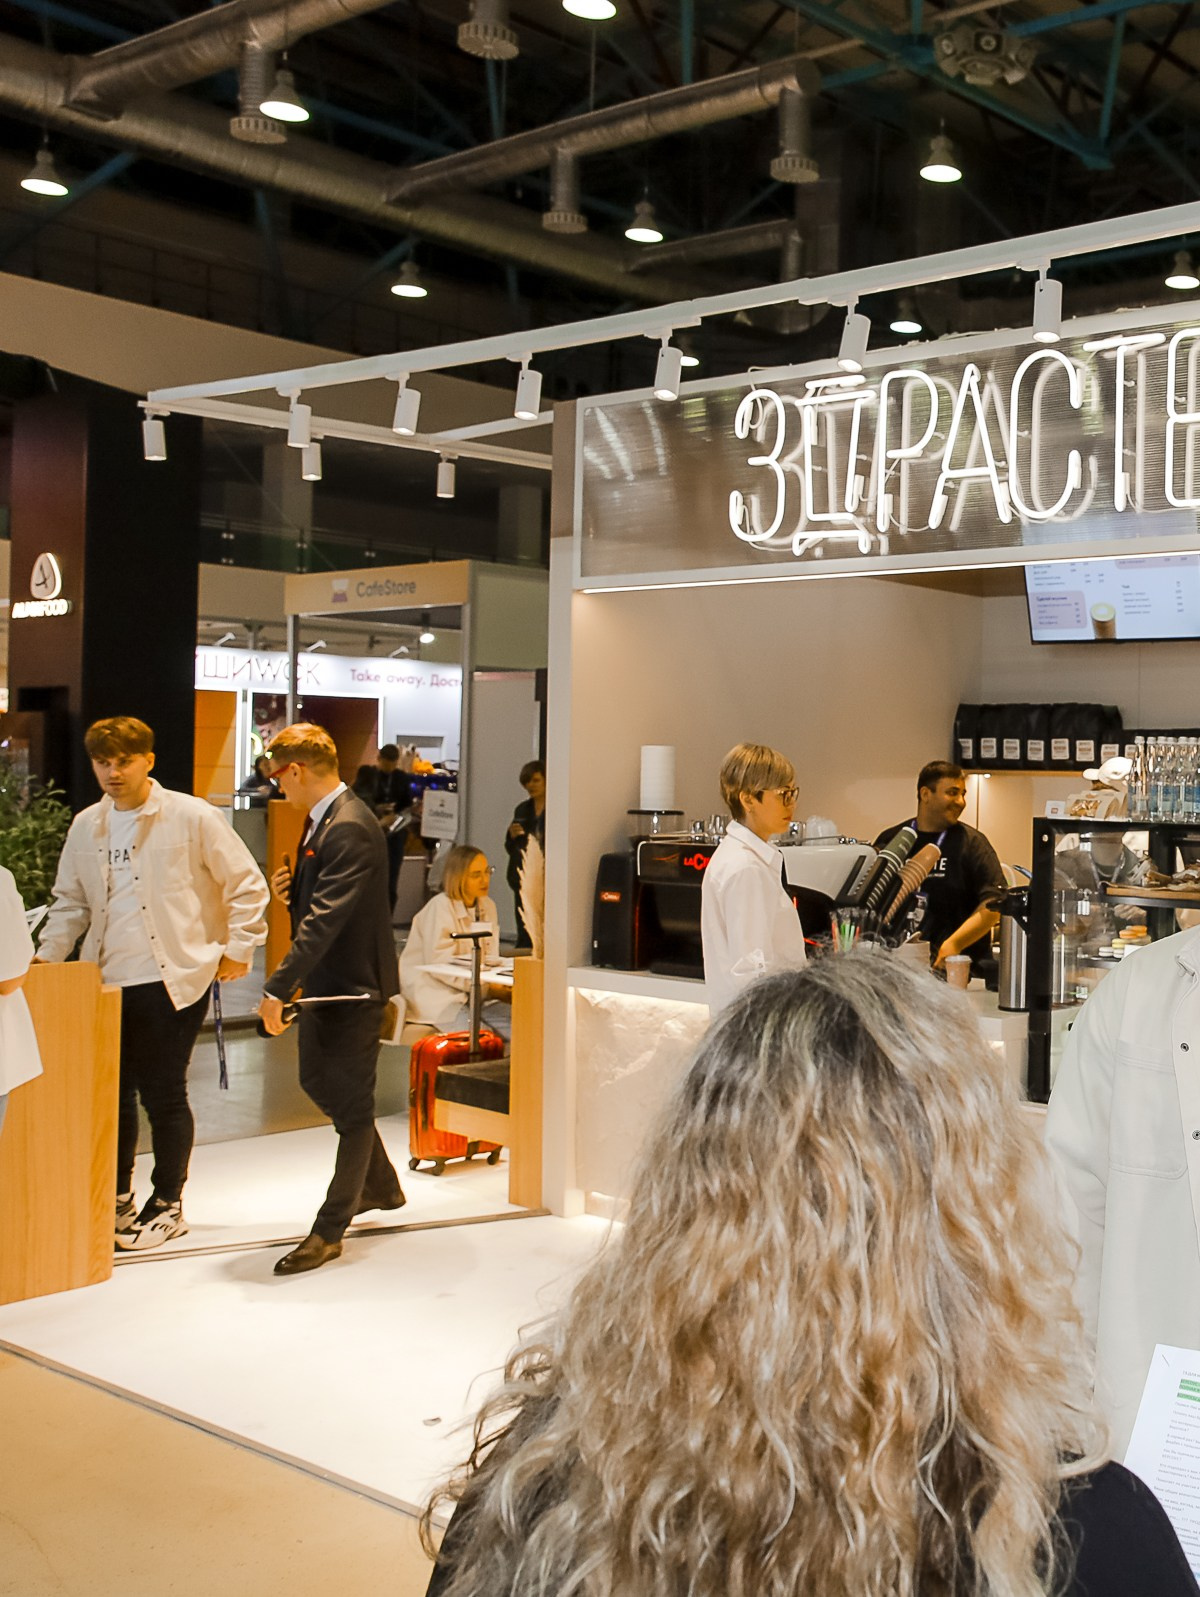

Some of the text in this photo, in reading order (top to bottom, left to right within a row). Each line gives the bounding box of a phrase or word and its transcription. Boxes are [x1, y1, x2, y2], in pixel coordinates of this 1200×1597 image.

[355, 579, 417, 598] CafeStore
[195, 653, 322, 686] ШИWOK
[350, 668, 462, 689] Take away. Дост
